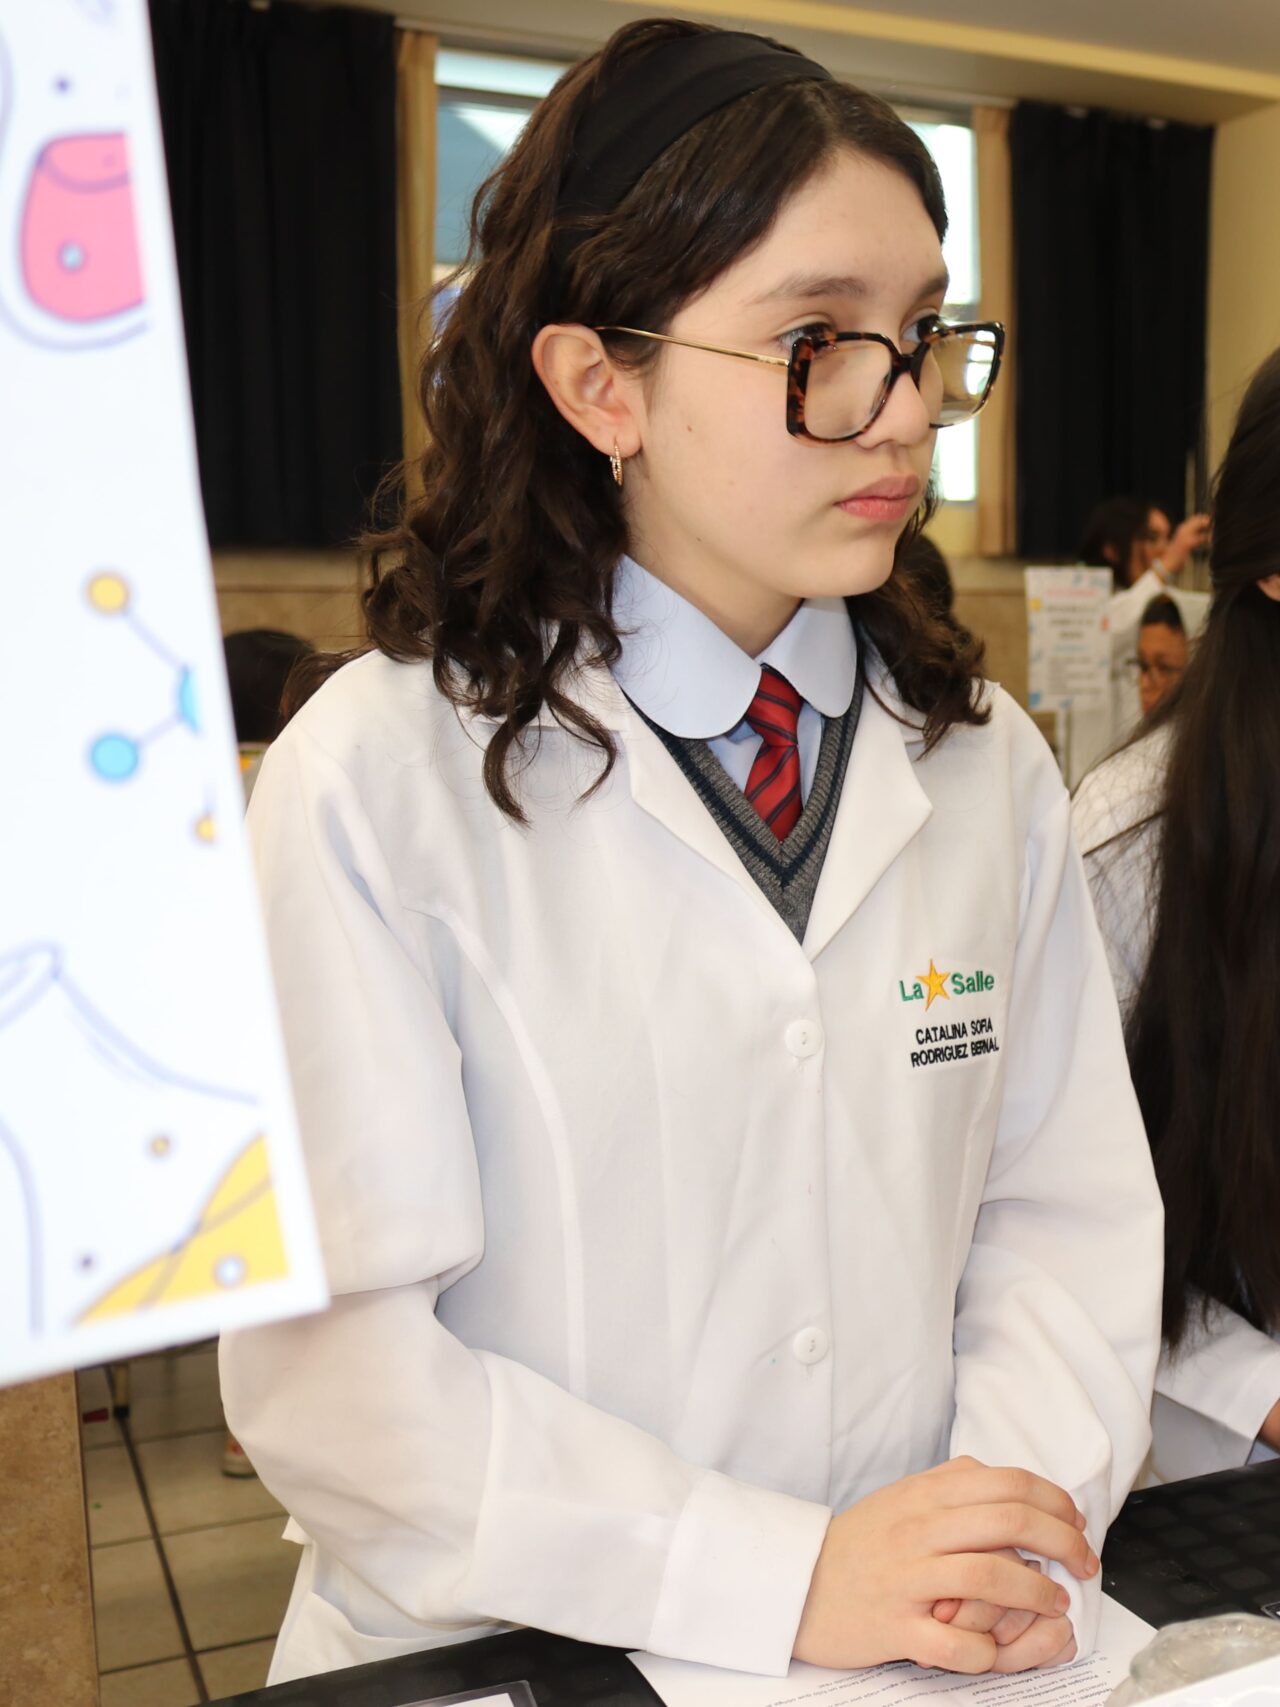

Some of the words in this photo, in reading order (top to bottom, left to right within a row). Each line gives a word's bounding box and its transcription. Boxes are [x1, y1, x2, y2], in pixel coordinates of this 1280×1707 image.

[898, 979, 924, 1002] La
[950, 970, 995, 996] Salle
[915, 1022, 968, 1045] CATALINA
[971, 1017, 993, 1037] SOFIA
[910, 1043, 969, 1068] RODRIGUEZ
[971, 1036, 1000, 1058] BERNAL
